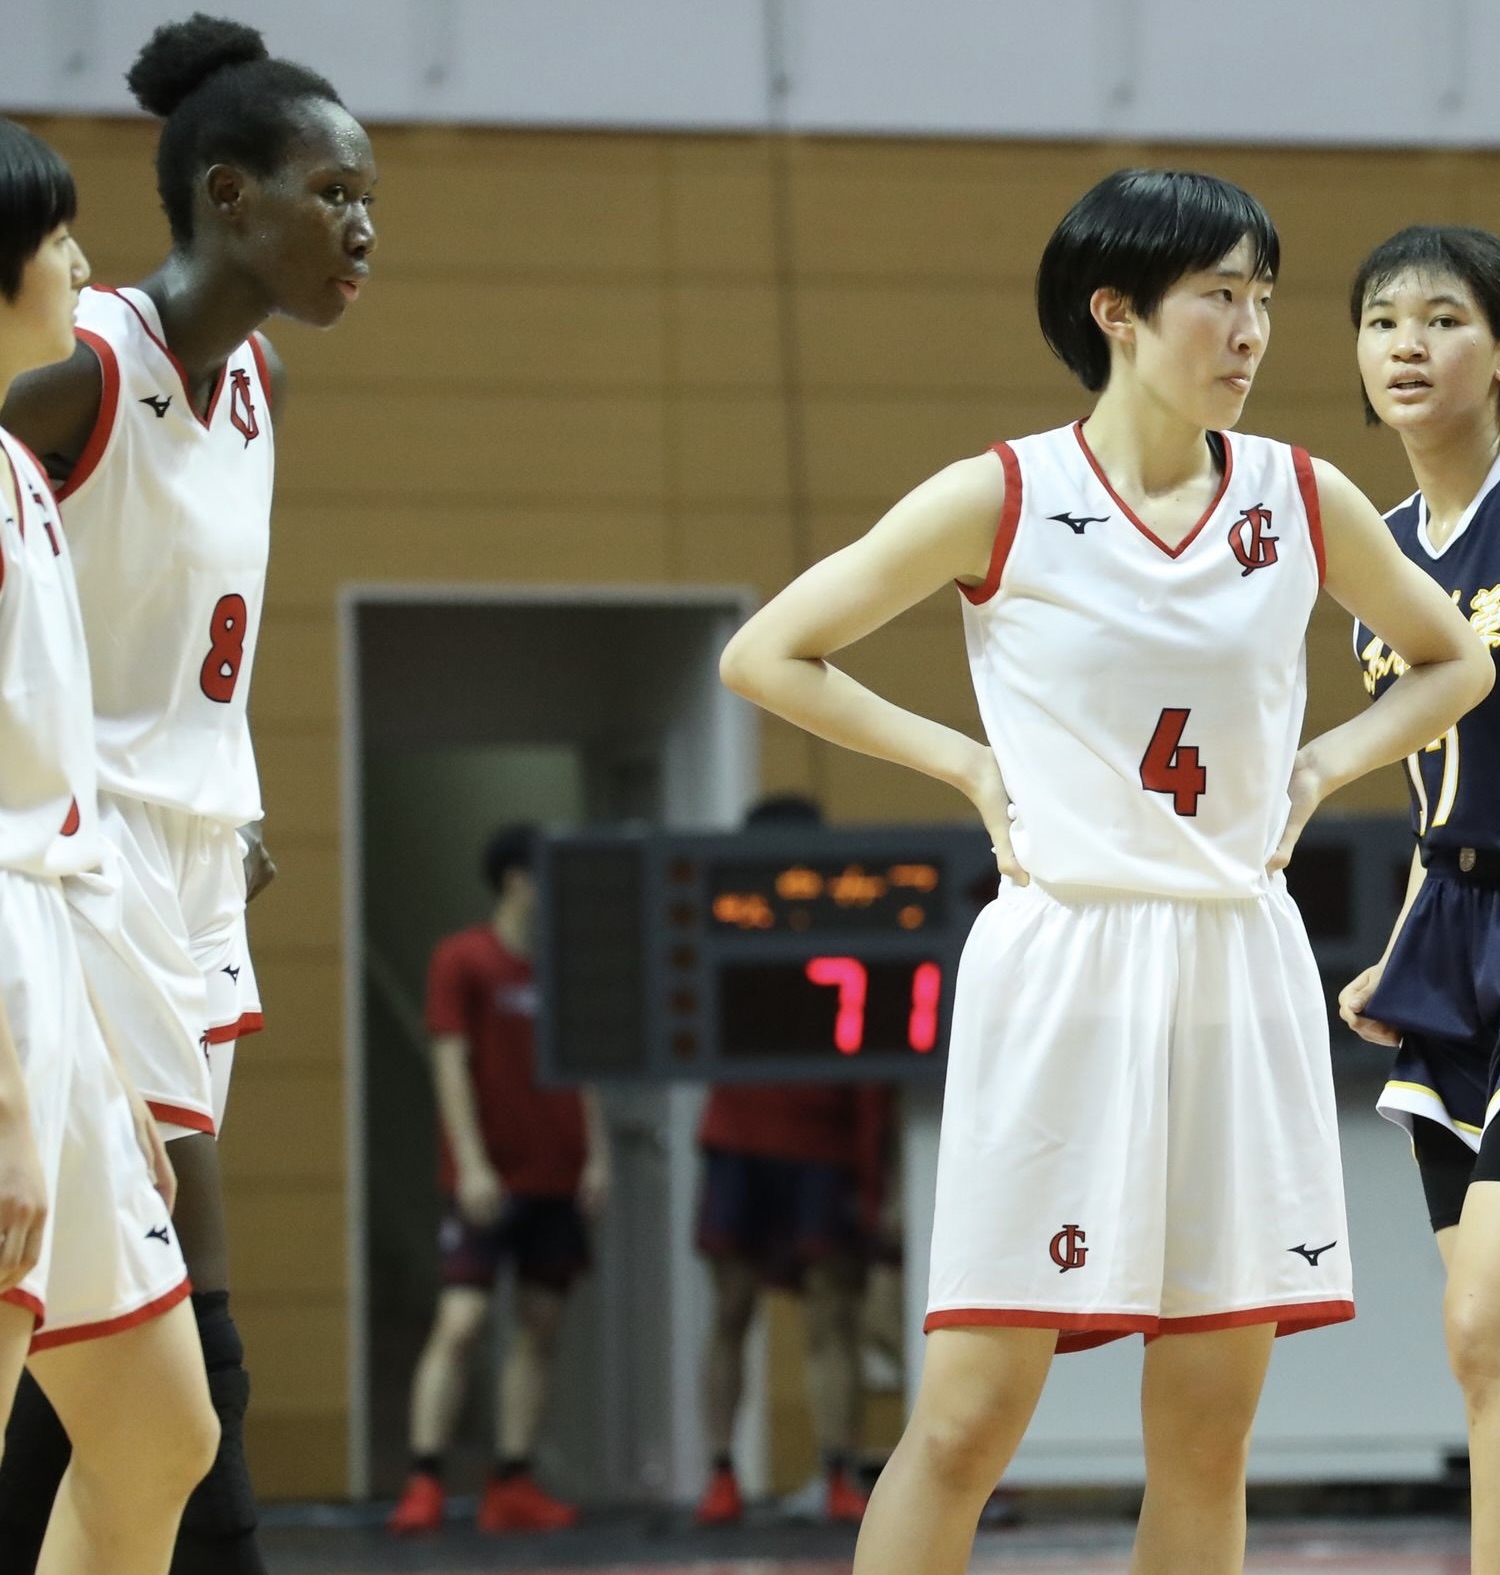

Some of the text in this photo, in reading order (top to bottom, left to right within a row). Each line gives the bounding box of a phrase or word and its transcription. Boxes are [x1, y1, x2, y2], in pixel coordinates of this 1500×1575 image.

[199, 593, 247, 704] 8
[1139, 707, 1207, 817] 4
[805, 956, 942, 1055] 71
